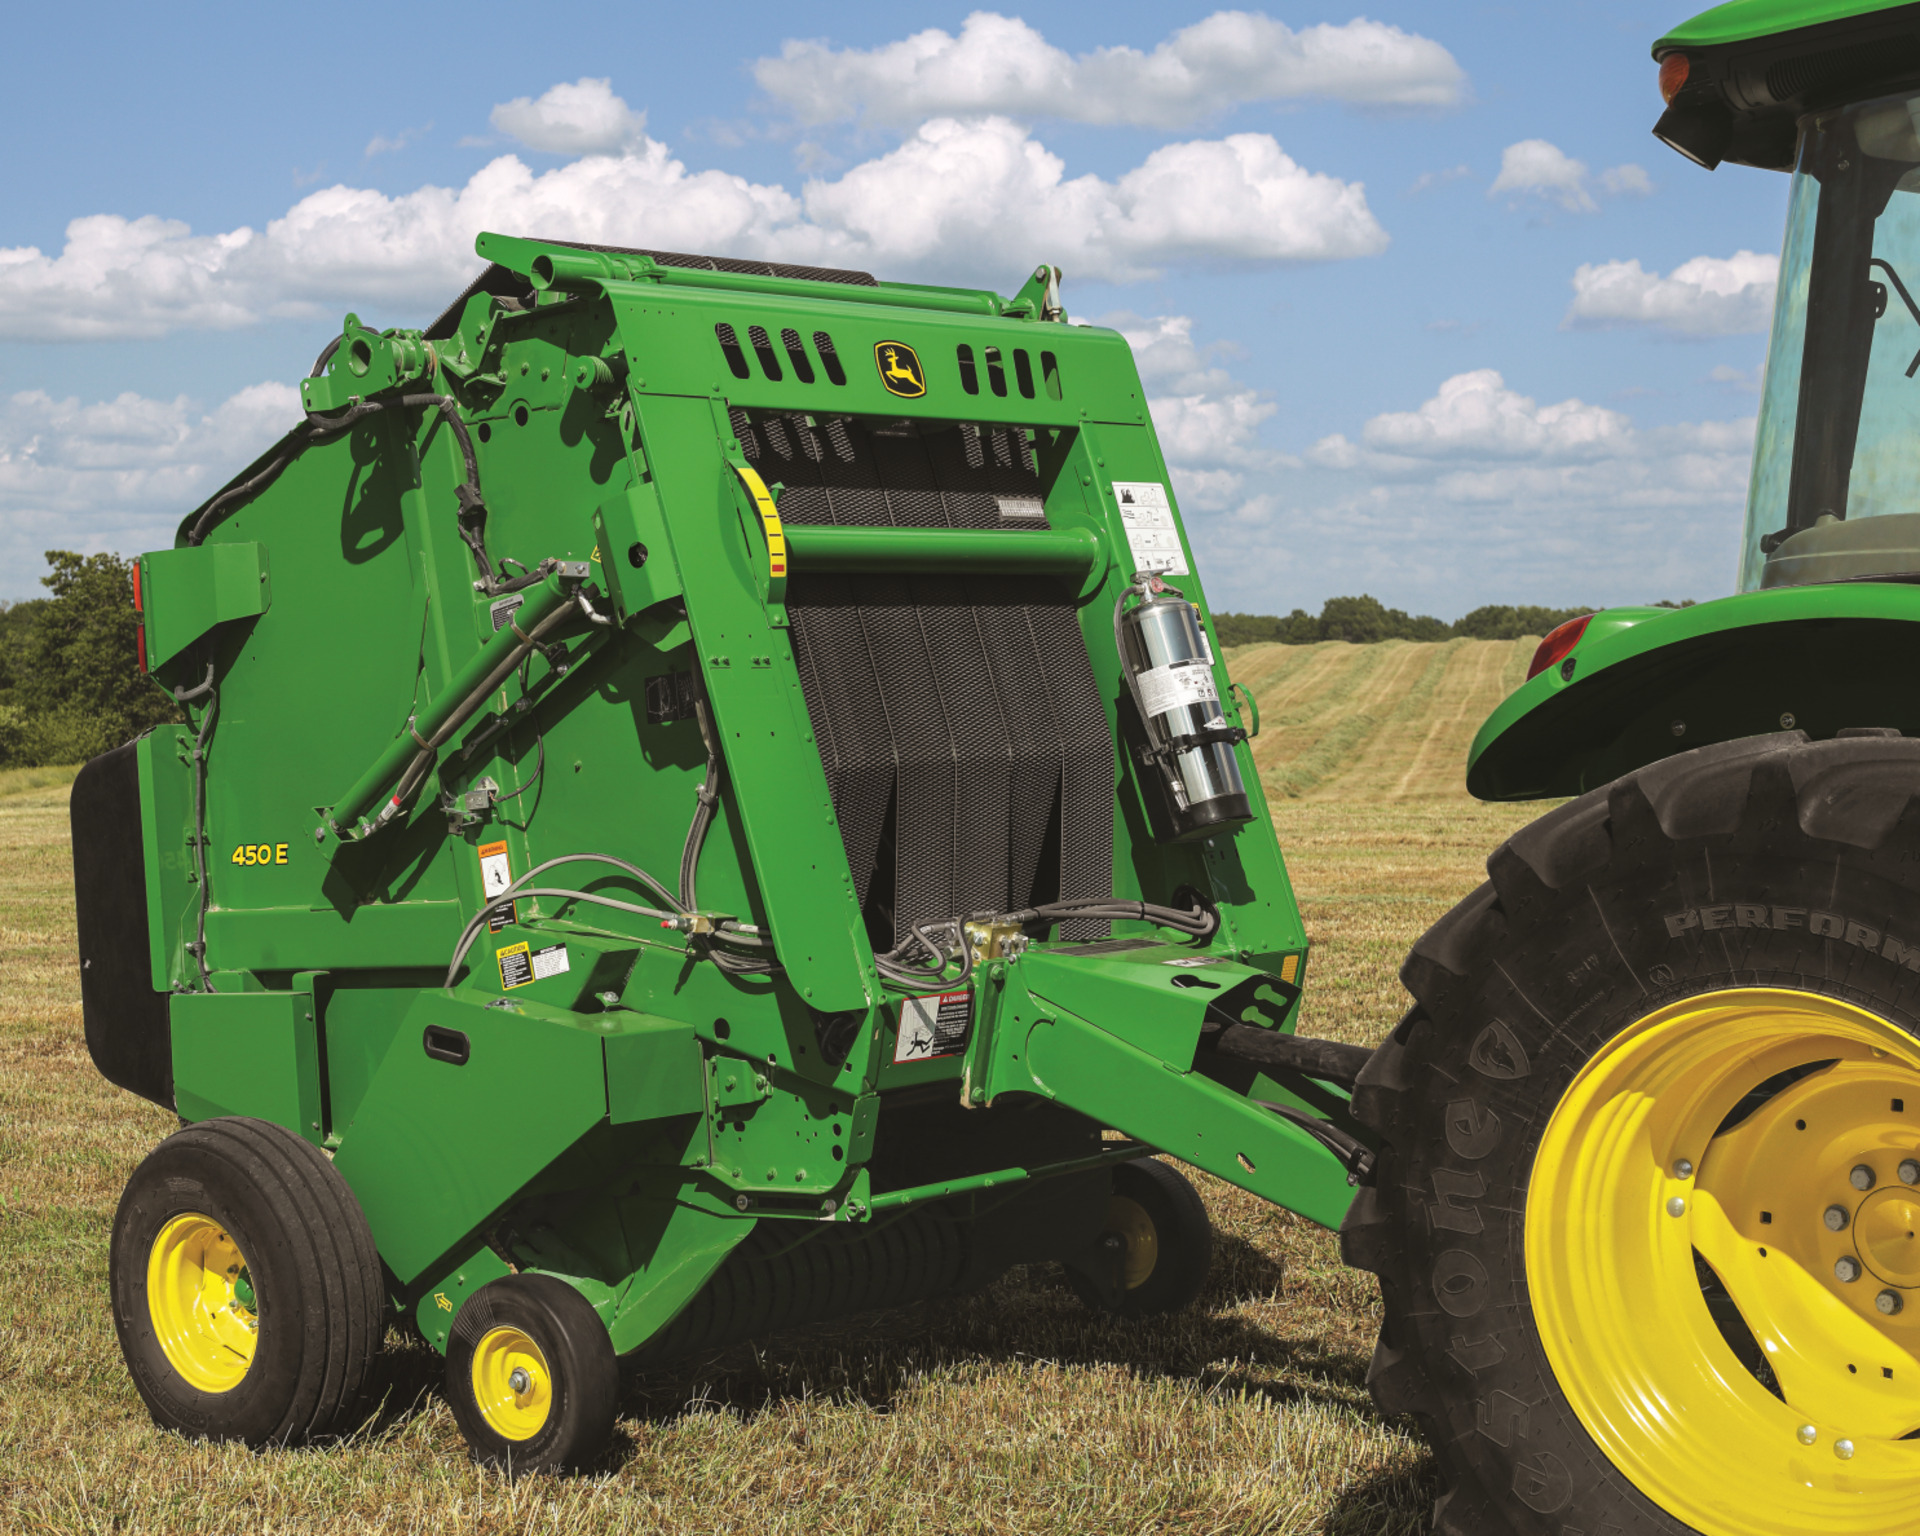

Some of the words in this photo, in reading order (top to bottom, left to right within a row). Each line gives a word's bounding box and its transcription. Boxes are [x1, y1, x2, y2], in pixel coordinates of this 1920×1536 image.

[231, 843, 272, 866] 450
[275, 842, 289, 865] E
[1663, 903, 1920, 972] PERFORM
[1428, 1098, 1625, 1536] estone
